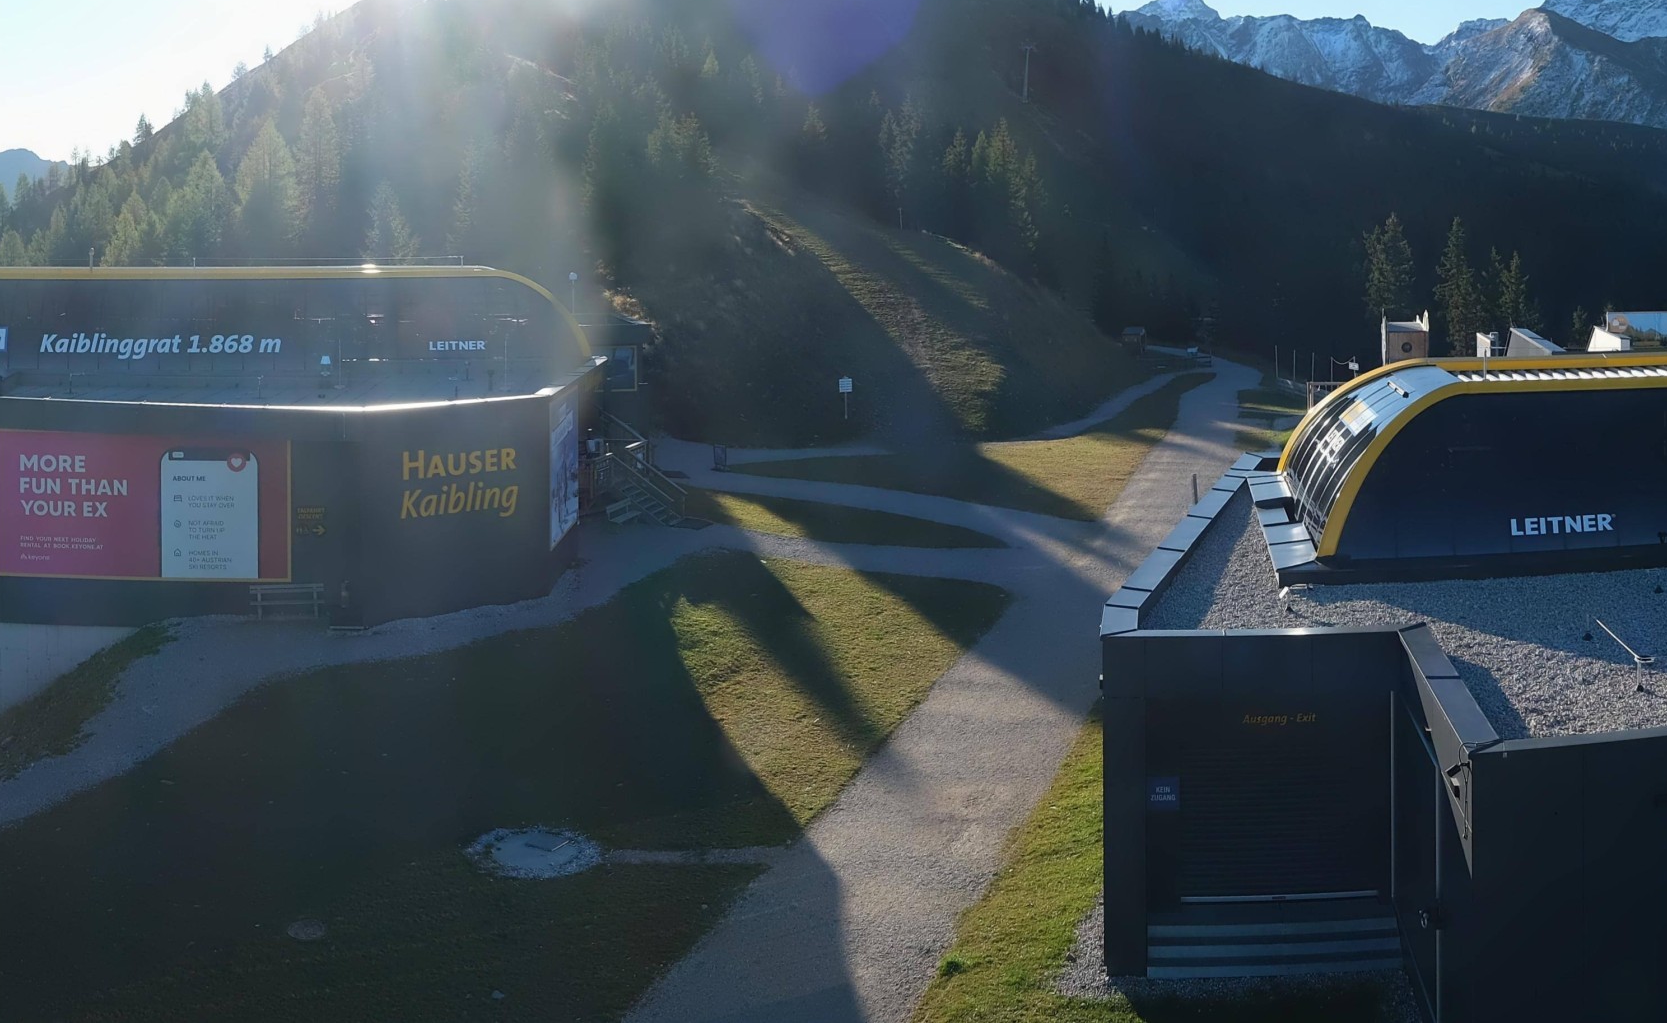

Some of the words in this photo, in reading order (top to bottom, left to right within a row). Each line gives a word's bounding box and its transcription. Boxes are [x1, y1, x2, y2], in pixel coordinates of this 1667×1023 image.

[40, 333, 182, 360] Kaiblinggrat
[187, 334, 253, 354] 1.868
[259, 338, 282, 353] m
[429, 340, 486, 351] LEITNER
[19, 454, 86, 473] MORE
[402, 448, 517, 481] HAUSER
[19, 477, 61, 494] FUN
[68, 478, 128, 496] THAN
[20, 499, 76, 516] YOUR
[83, 501, 108, 517] EX
[401, 481, 519, 519] Kaibling
[1510, 514, 1614, 536] LEITNER
[1242, 714, 1288, 726] Ausgang
[1296, 713, 1316, 723] Exit
[1150, 794, 1176, 802] ZUGANG
[1155, 786, 1171, 794] KEIN
